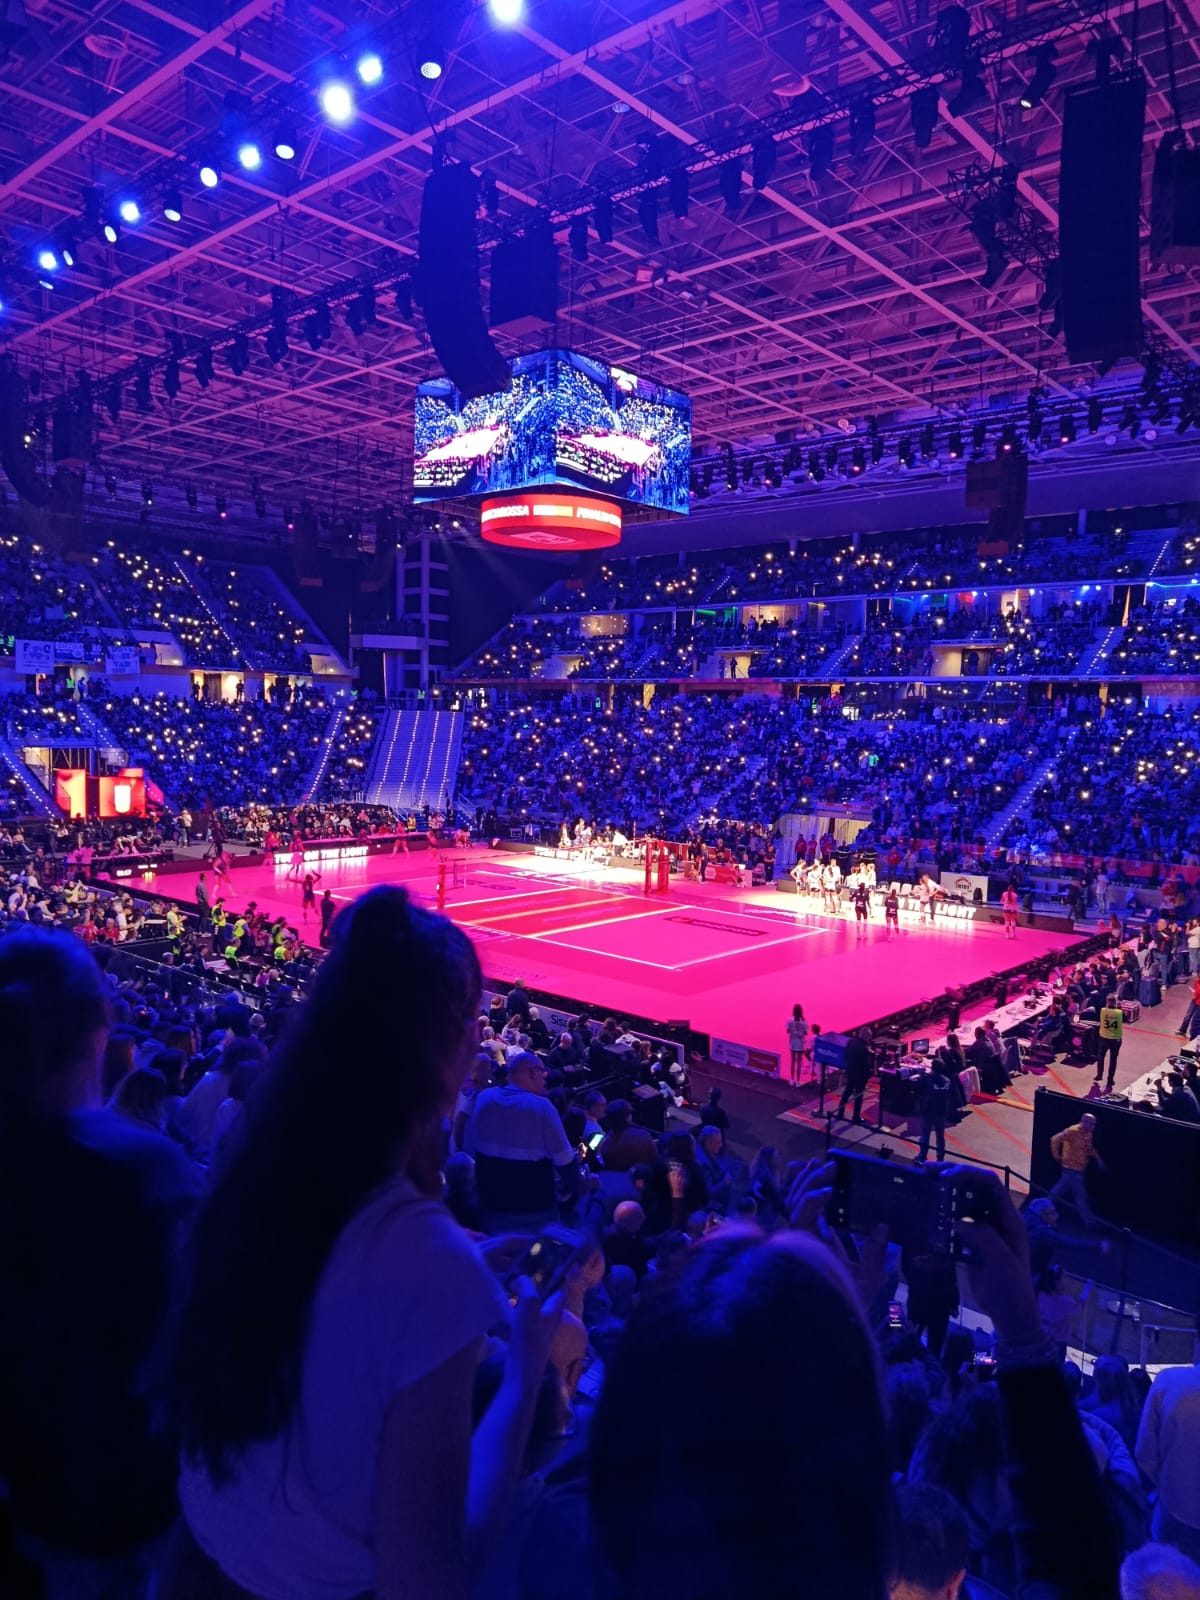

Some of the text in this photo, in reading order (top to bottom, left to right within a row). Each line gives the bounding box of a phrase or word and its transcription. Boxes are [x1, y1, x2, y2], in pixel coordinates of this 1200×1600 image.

[303, 850, 319, 862] ON
[340, 846, 369, 859] LIGHT
[935, 903, 976, 919] LIGHT
[1103, 1020, 1119, 1030] 34
